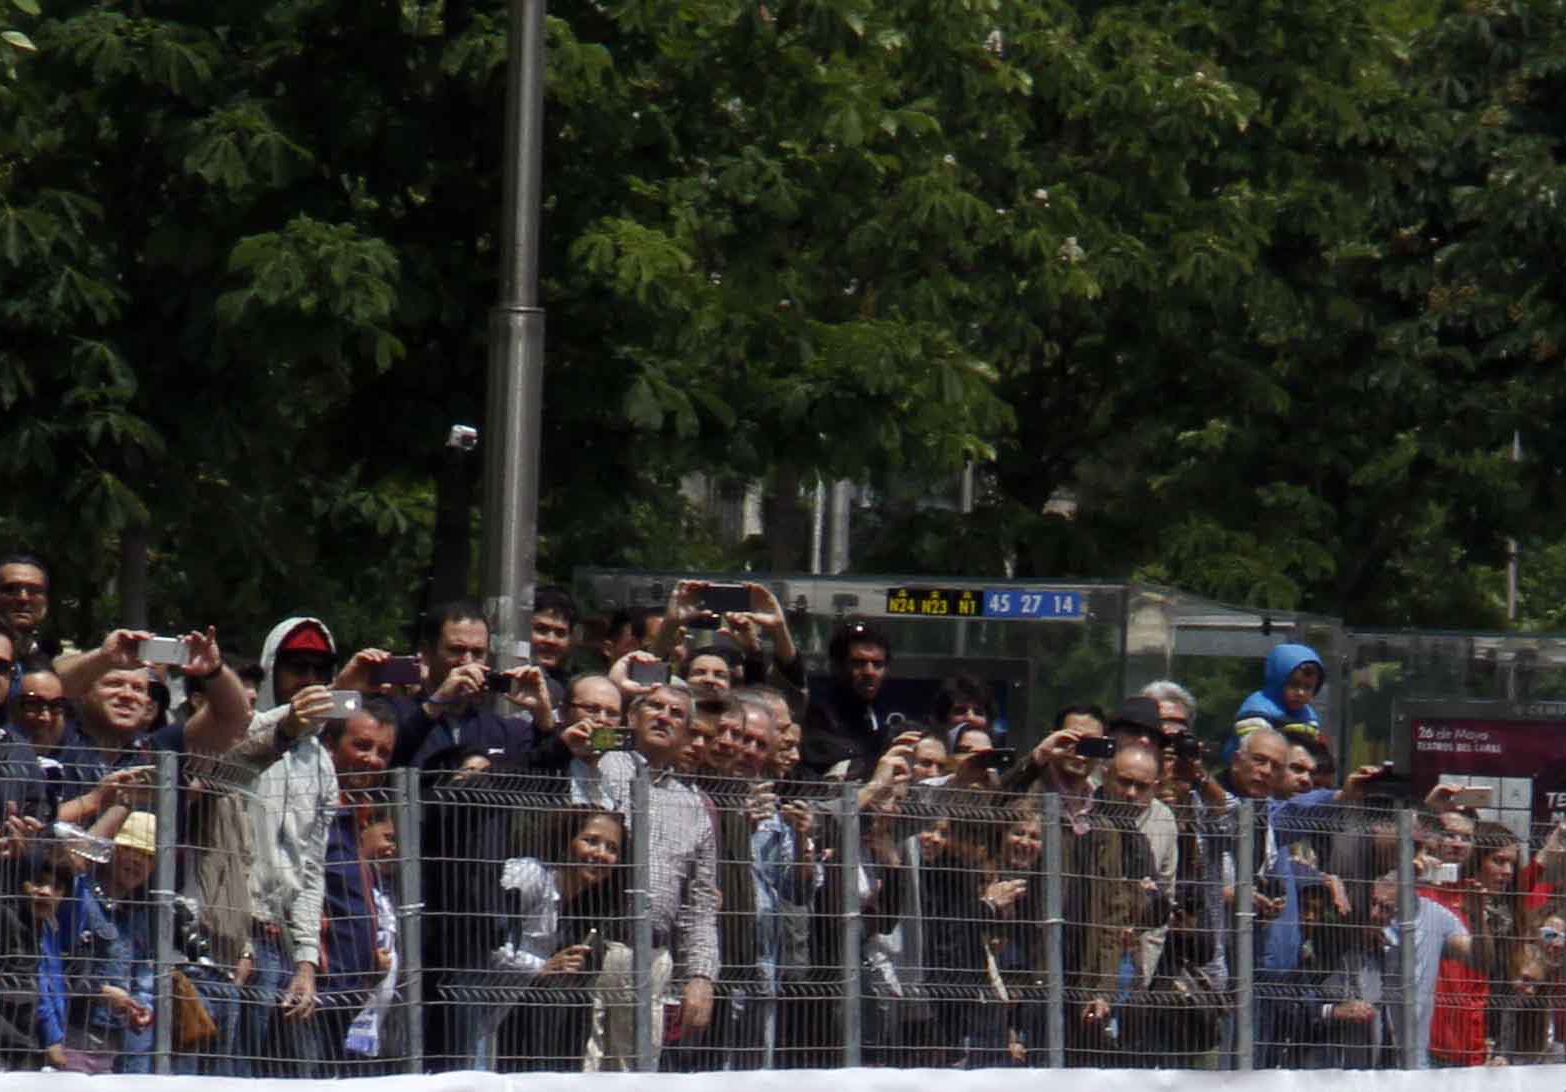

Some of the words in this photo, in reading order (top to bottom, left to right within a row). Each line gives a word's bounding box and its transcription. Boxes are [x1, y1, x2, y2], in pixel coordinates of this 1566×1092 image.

[889, 598, 915, 612] N24
[922, 599, 948, 614] N23
[959, 600, 977, 614] N1
[989, 595, 1010, 612] 45
[1021, 595, 1042, 612] 27
[1054, 595, 1072, 612] 14
[1418, 726, 1433, 739] 26
